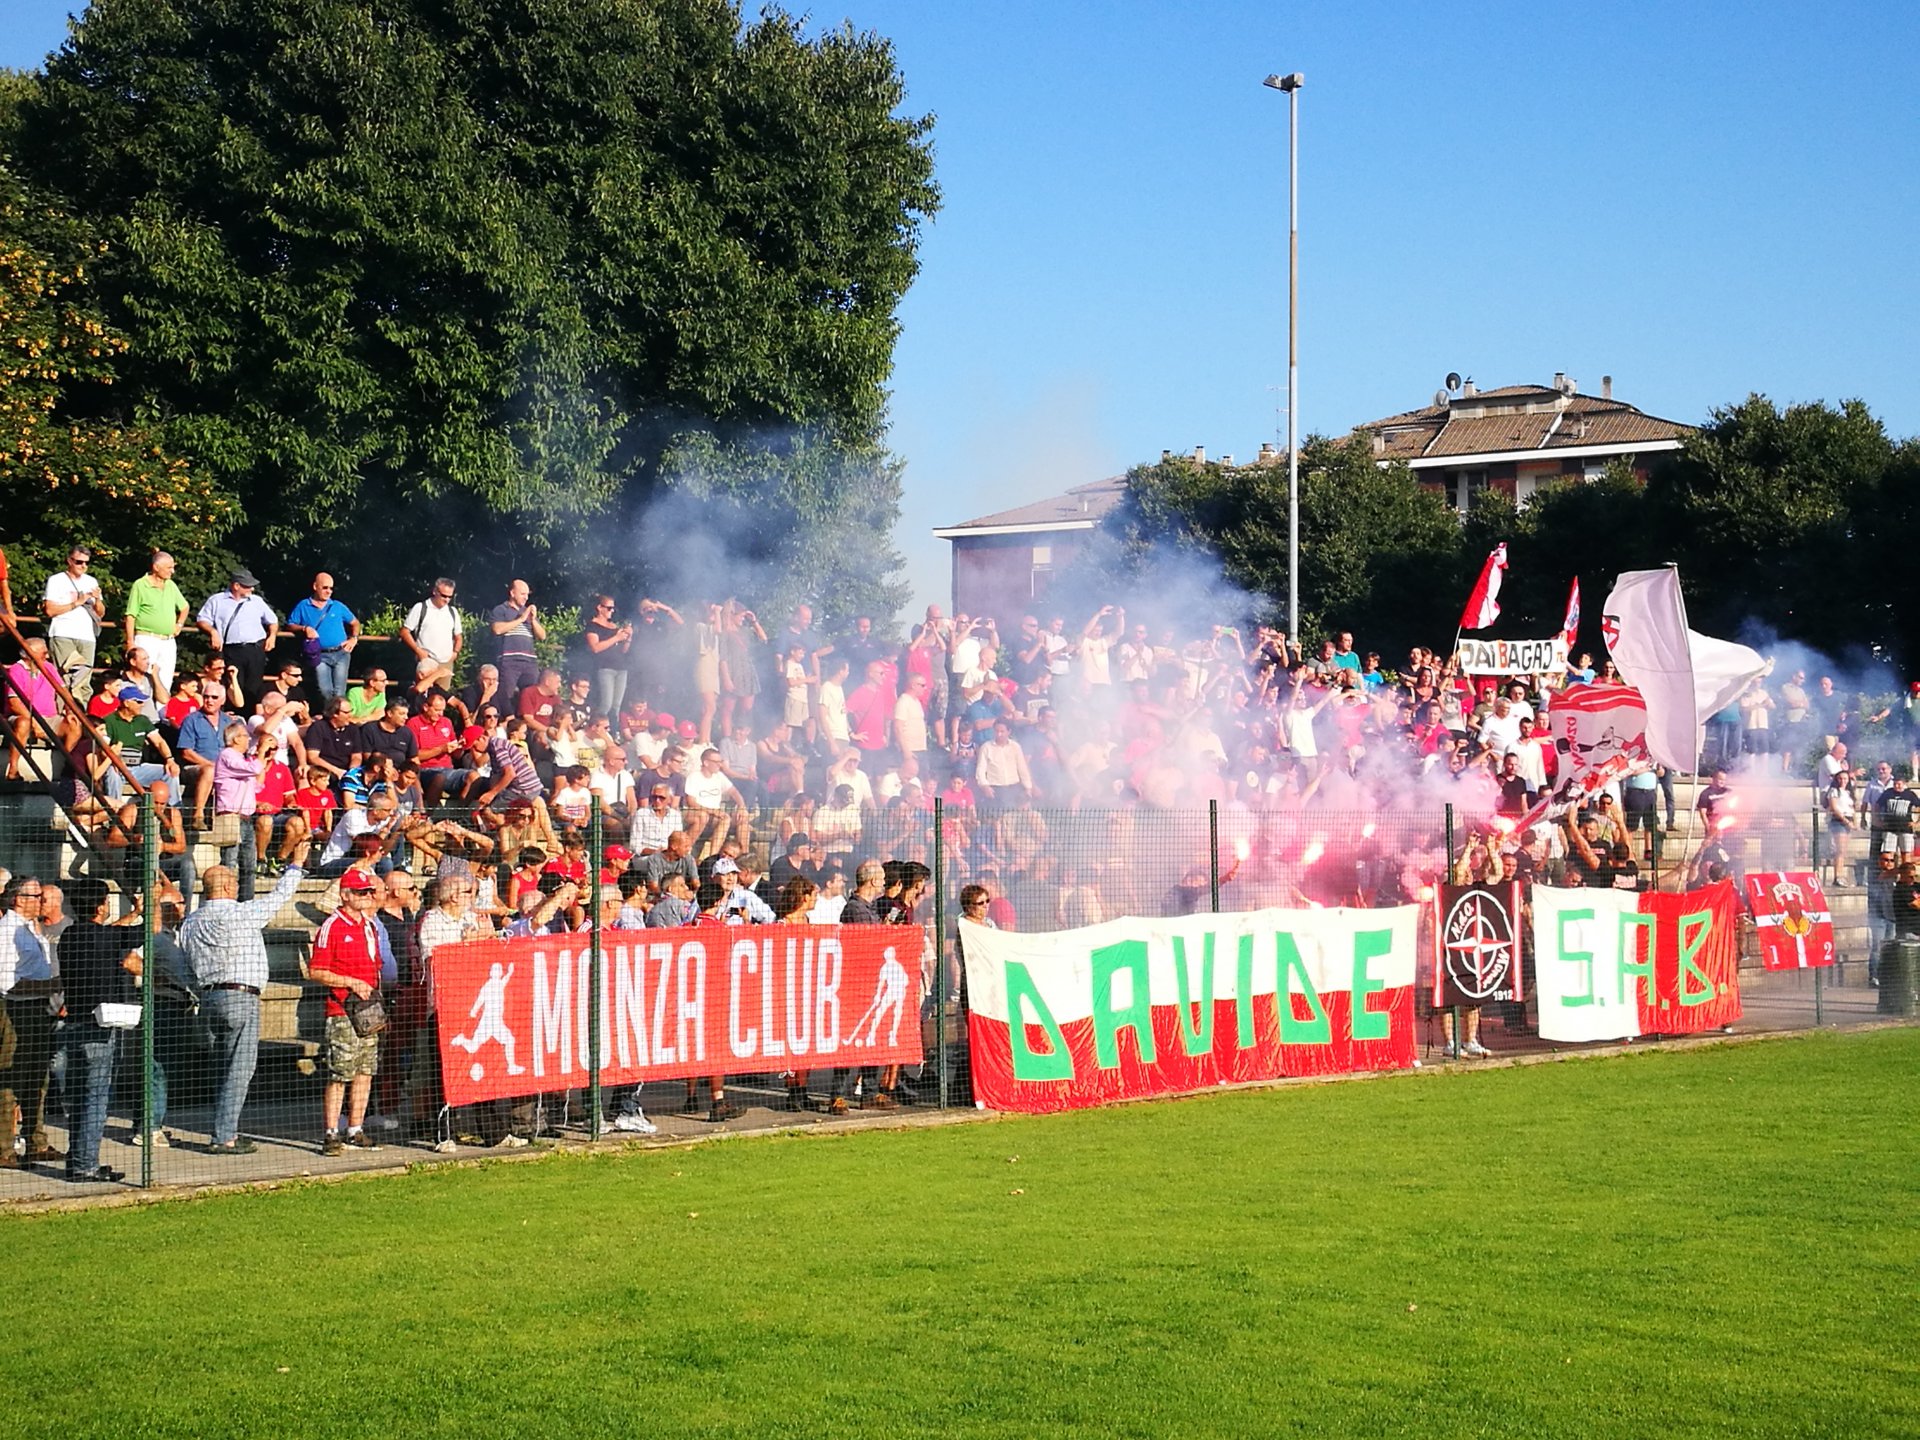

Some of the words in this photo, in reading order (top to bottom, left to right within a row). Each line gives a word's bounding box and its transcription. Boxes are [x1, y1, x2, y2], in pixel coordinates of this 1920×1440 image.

[1498, 642, 1553, 671] BAGAJ
[1752, 878, 1765, 897] 1
[1807, 876, 1819, 894] 9
[1769, 945, 1780, 965] 1
[1823, 941, 1833, 960] 2
[532, 941, 707, 1077] MONZA
[729, 938, 843, 1058] CLUB
[1005, 928, 1393, 1081] DAVIDE
[1492, 989, 1514, 1001] 1912
